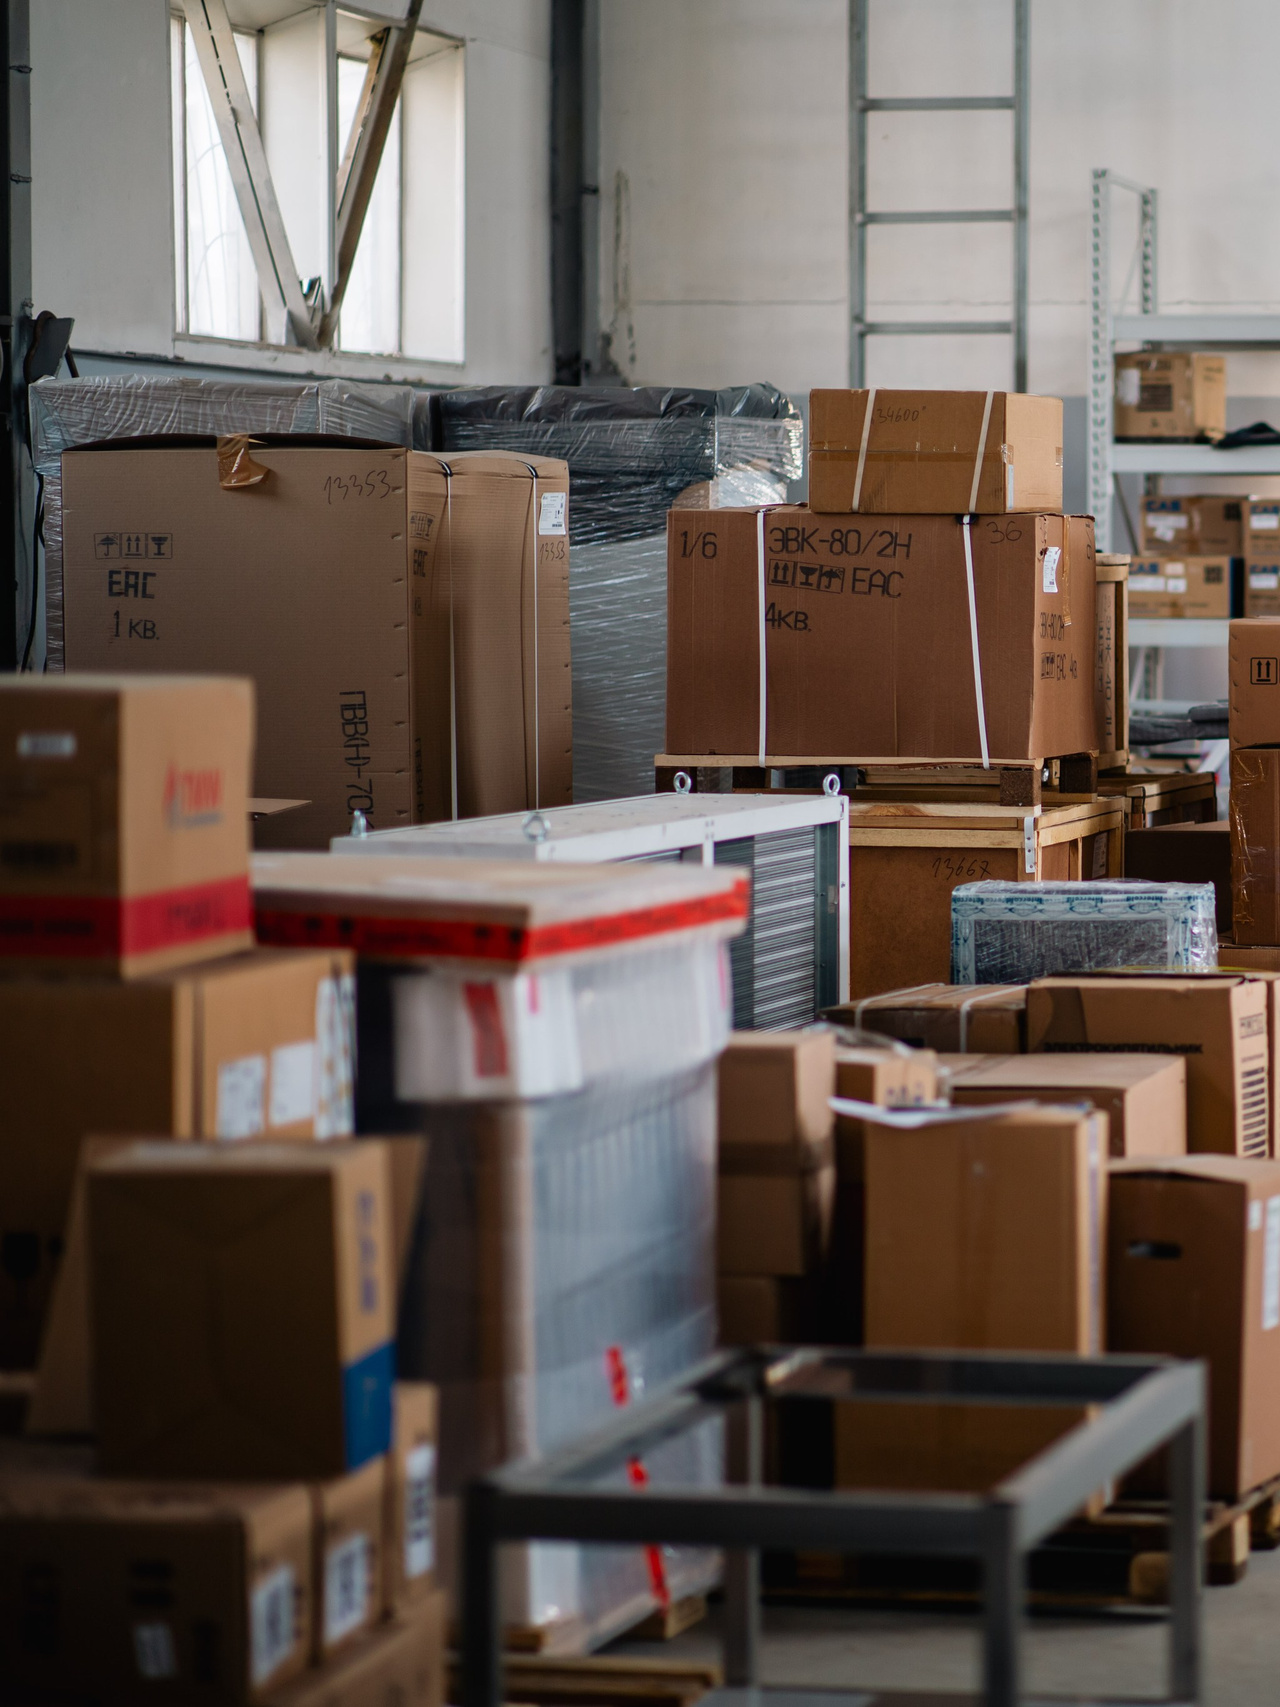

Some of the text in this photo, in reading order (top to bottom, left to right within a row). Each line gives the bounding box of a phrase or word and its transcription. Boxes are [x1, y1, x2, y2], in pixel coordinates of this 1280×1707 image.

[324, 471, 393, 504] 13353
[681, 530, 718, 559] 1/6
[768, 527, 913, 560] ЭВК-80/2Н
[986, 521, 1023, 544] 36
[108, 570, 156, 599] EAC
[851, 567, 904, 598] EAC
